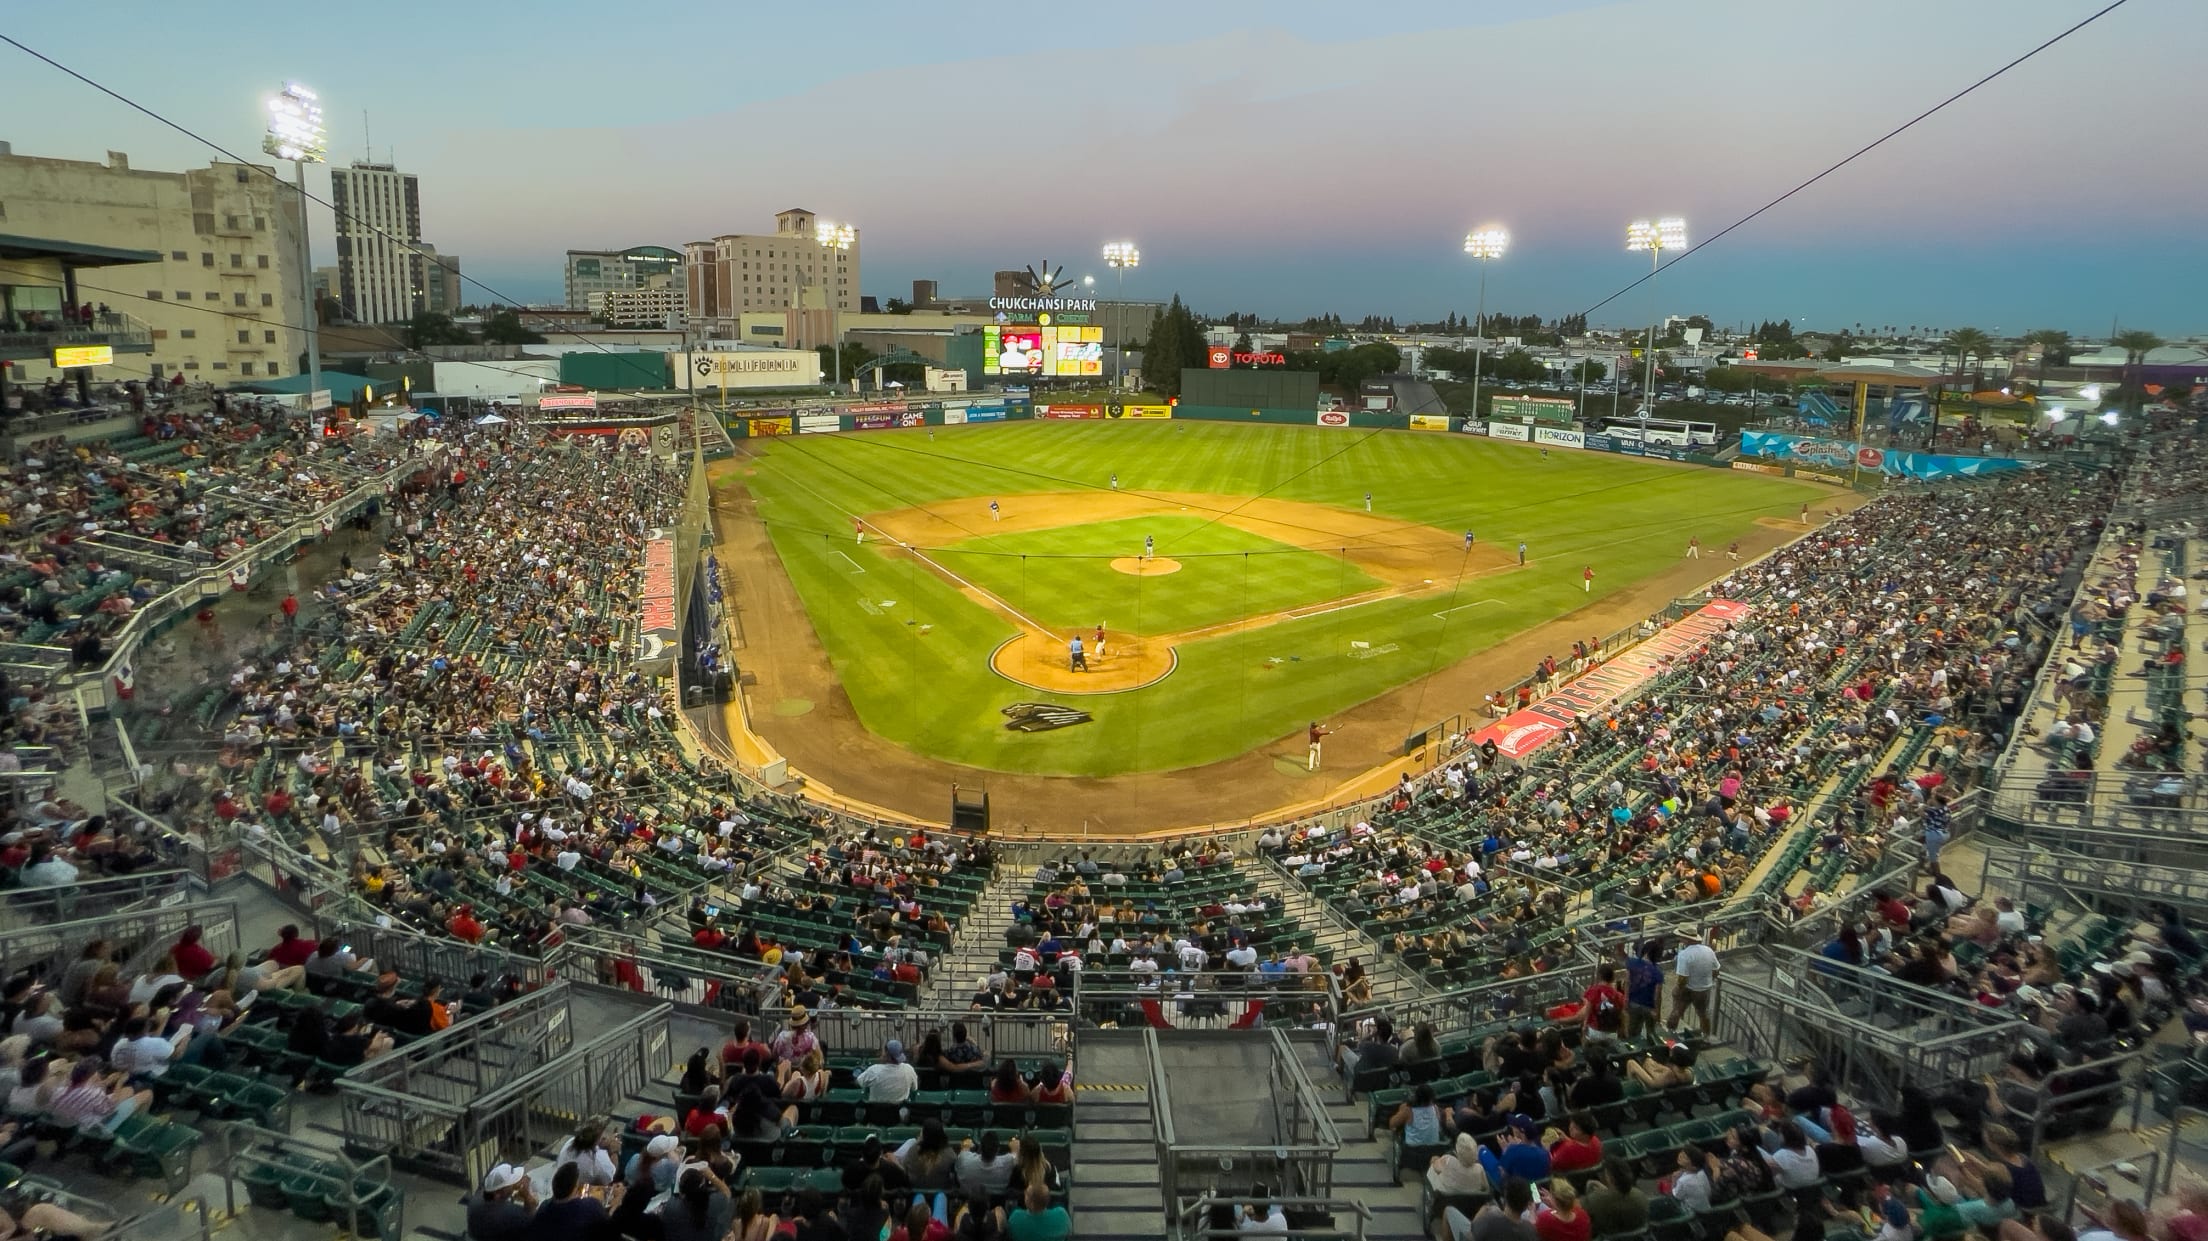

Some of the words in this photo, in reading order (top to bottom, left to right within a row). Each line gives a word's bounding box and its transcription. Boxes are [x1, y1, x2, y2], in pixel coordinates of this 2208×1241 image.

[989, 297, 1064, 310] CHUKCHANSI
[1067, 299, 1096, 311] PARK
[1234, 353, 1286, 365] TOYOTA
[902, 411, 924, 421] GAME
[1539, 429, 1582, 443] HORIZON
[1528, 664, 1645, 723] FRESNO
